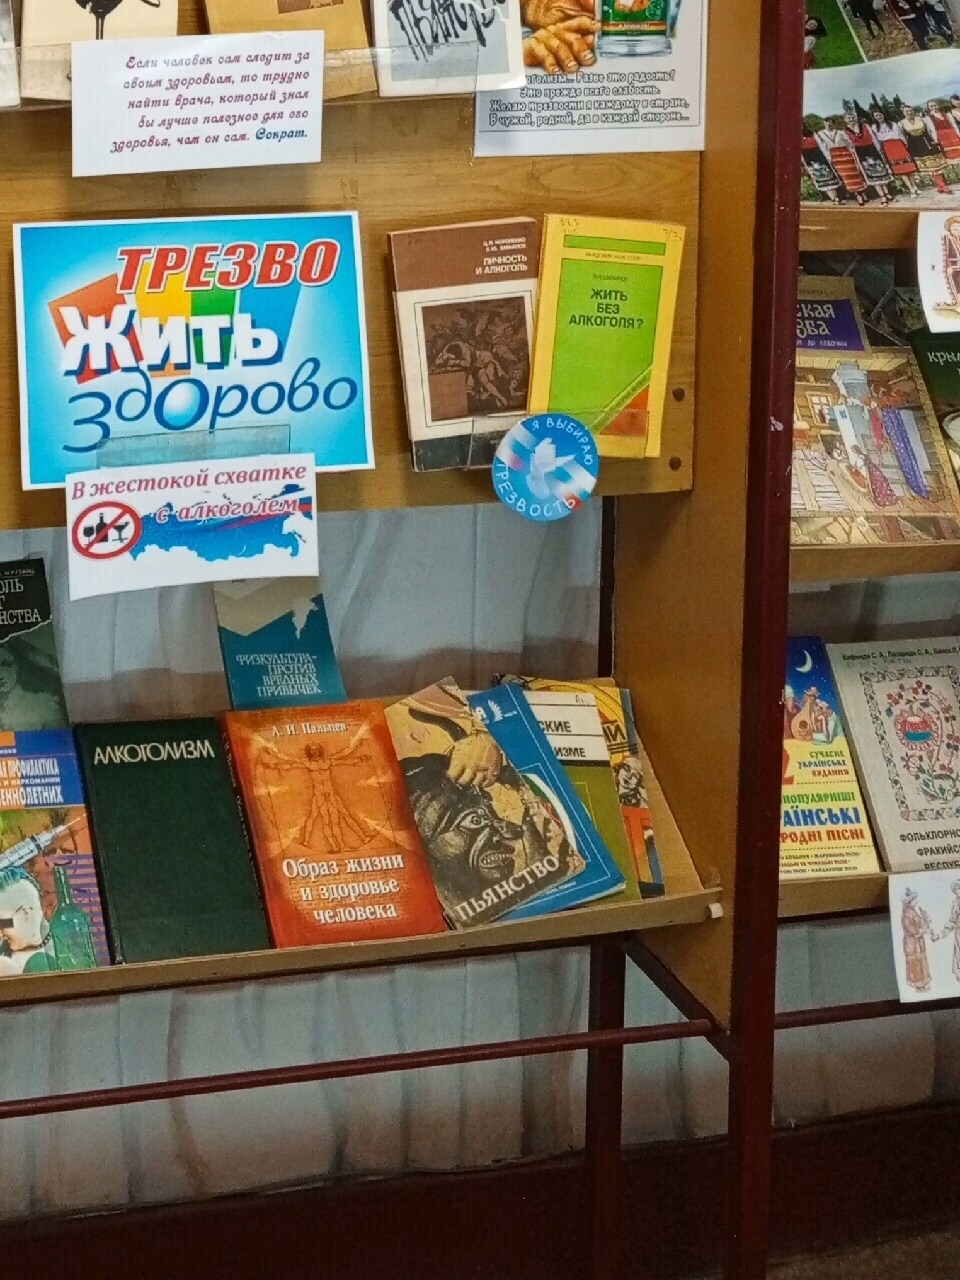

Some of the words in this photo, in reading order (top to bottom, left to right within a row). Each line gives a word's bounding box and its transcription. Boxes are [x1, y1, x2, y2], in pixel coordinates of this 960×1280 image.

[126, 56, 157, 69] Если
[164, 55, 212, 67] человек
[218, 55, 241, 64] сам
[246, 52, 291, 66] следит
[295, 51, 310, 65] за
[263, 71, 309, 85] трудно
[256, 127, 308, 142] Сократ.
[117, 240, 340, 294] ТРЕЗВО
[483, 254, 528, 266] ЛИЧНОСТЬ
[475, 266, 483, 275] И
[484, 264, 528, 275] АЛКОГОЛЬ
[590, 288, 628, 301] ЖИТЬ
[597, 303, 620, 314] БЕЗ
[569, 315, 643, 330] АЛКОГОЛЯ?
[546, 418, 594, 466] ВЫБИРАЮ
[72, 481, 85, 500] В
[89, 467, 209, 497] жестокой
[215, 465, 307, 486] схватке
[496, 462, 577, 517] ТРЕЗВОСТЬ
[156, 507, 169, 523] с
[177, 497, 300, 521] алкоголем
[269, 663, 317, 674] ПРОТИВ
[263, 673, 318, 685] ВРЕДНЫХ
[257, 683, 322, 697] ПРИВЫЧЕК
[302, 720, 347, 734] Пальцев
[94, 739, 215, 765] АЛКОГОЛИЗМ
[7, 758, 60, 777] ПРОФИЛАКТИКА
[826, 828, 865, 840] ПІСНІ
[283, 858, 342, 880] Образ
[346, 853, 404, 873] жизни
[300, 885, 314, 899] и
[319, 878, 400, 901] здоровье
[454, 854, 560, 922] ПЬЯНСТВО
[313, 904, 398, 926] человека
